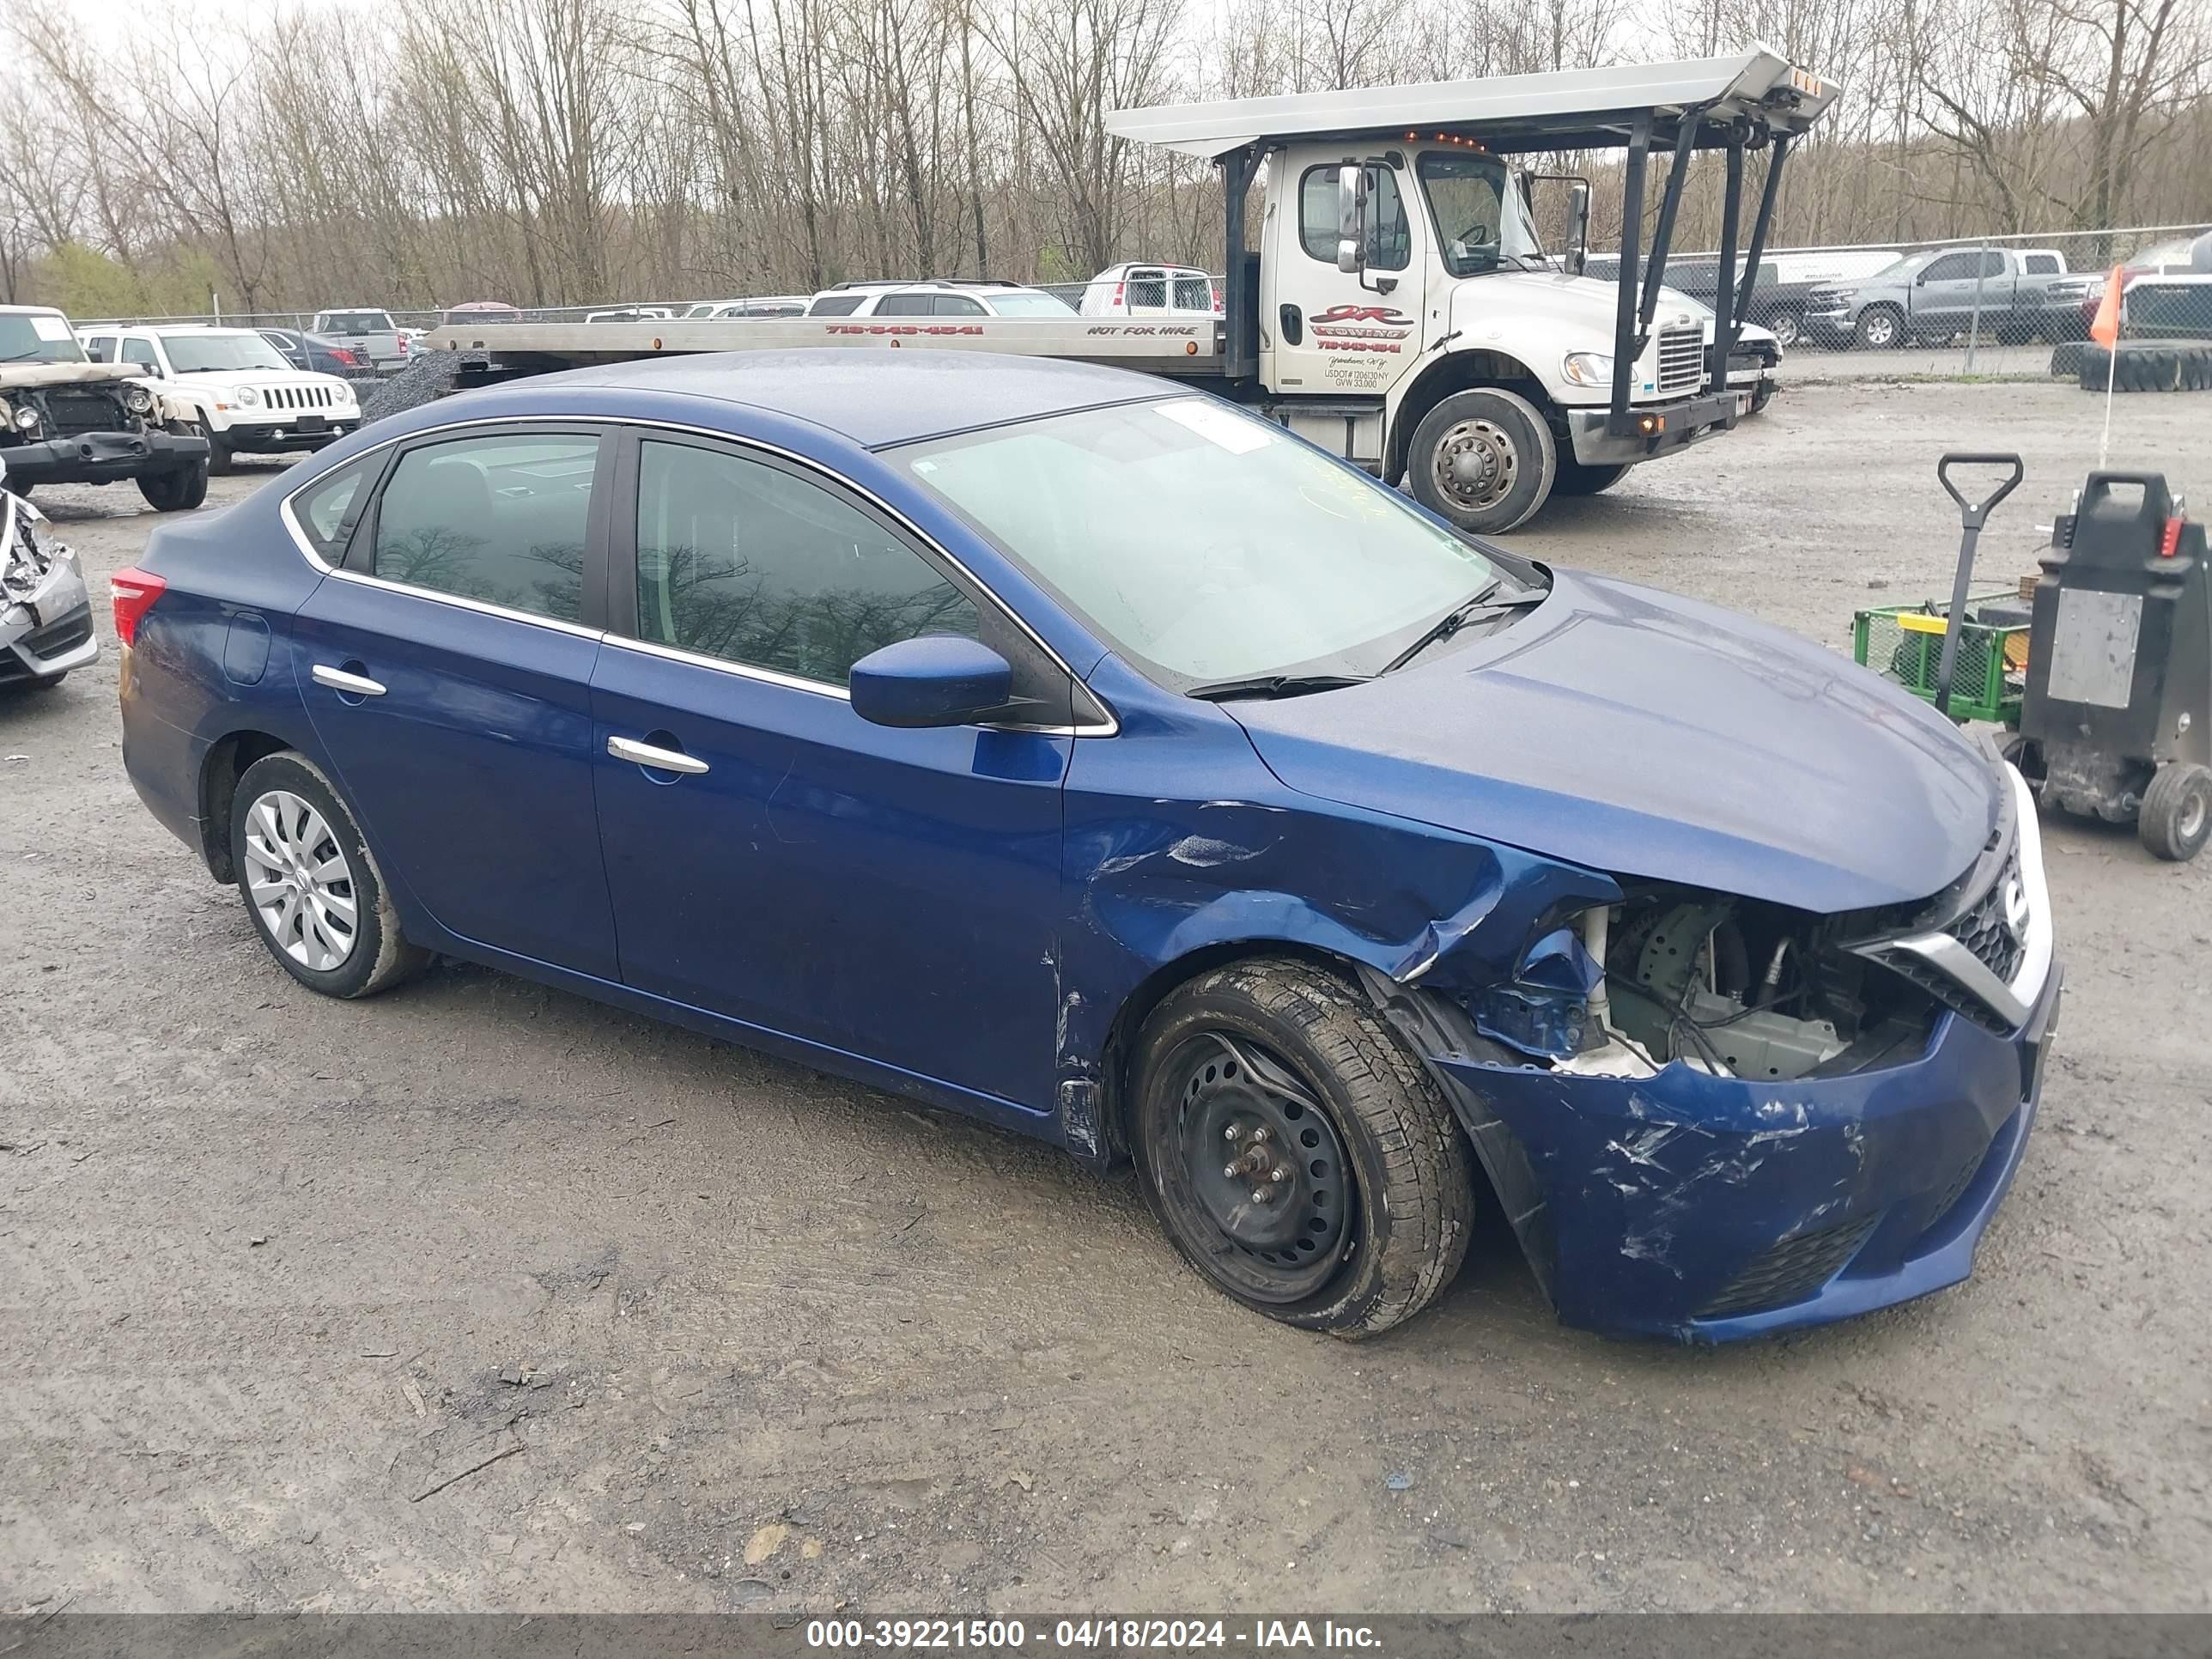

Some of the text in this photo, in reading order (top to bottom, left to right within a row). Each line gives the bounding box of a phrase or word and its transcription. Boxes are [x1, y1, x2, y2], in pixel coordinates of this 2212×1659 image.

[1087, 326, 1198, 336] NOT FOR HIRE
[1322, 327, 1402, 338] TOWING
[1335, 379, 1353, 387] GVW
